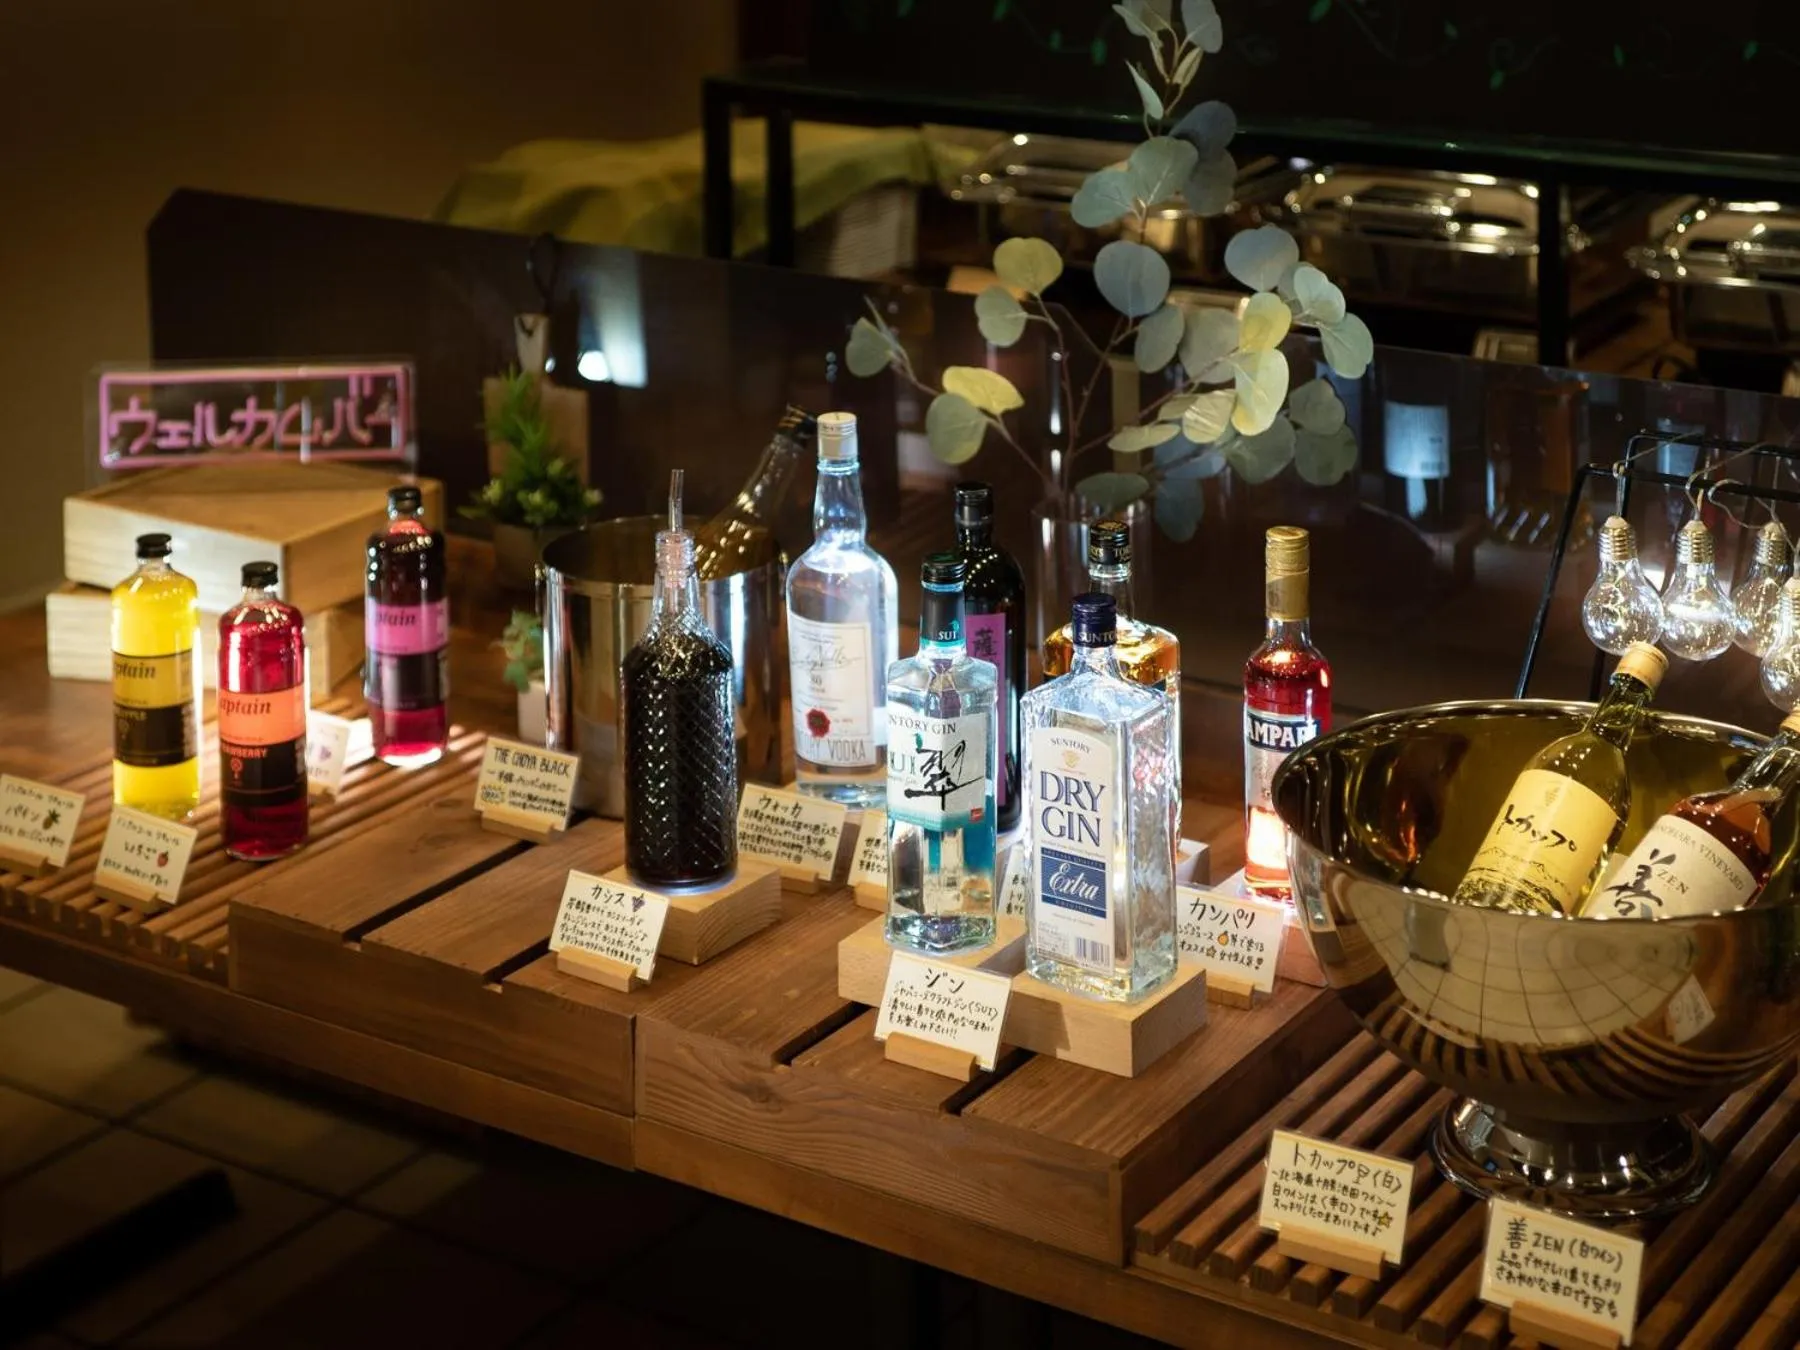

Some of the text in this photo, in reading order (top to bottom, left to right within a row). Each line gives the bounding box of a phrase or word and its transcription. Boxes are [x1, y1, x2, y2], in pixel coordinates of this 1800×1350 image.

[108, 375, 396, 453] ウェルカムバー
[938, 630, 957, 642] SUI
[972, 626, 998, 658] 薩
[1079, 630, 1117, 643] SUNTO
[219, 698, 271, 715] aptain
[888, 713, 957, 736] NTORY GIN
[1247, 715, 1318, 748] AMPARI
[828, 739, 867, 762] VODKA
[1050, 737, 1091, 755] SUNTORY
[494, 746, 510, 765] THE
[540, 757, 570, 778] BLACK
[889, 752, 916, 775] UI
[904, 739, 984, 811] 翠
[759, 793, 804, 818] ウォッカ
[1040, 771, 1106, 812] DRY
[1041, 806, 1102, 848] GIN
[1049, 862, 1100, 901] Extra
[1699, 843, 1746, 891] VINEYARD
[591, 884, 626, 908] カシス
[1656, 869, 1690, 896] ZEN
[1190, 897, 1256, 929] カンパリ
[1178, 922, 1214, 939] ンジジュース
[925, 968, 965, 994] ジン
[1293, 1142, 1355, 1175] トカップ
[1506, 1216, 1528, 1249] 善
[1532, 1232, 1565, 1254] ZEN
